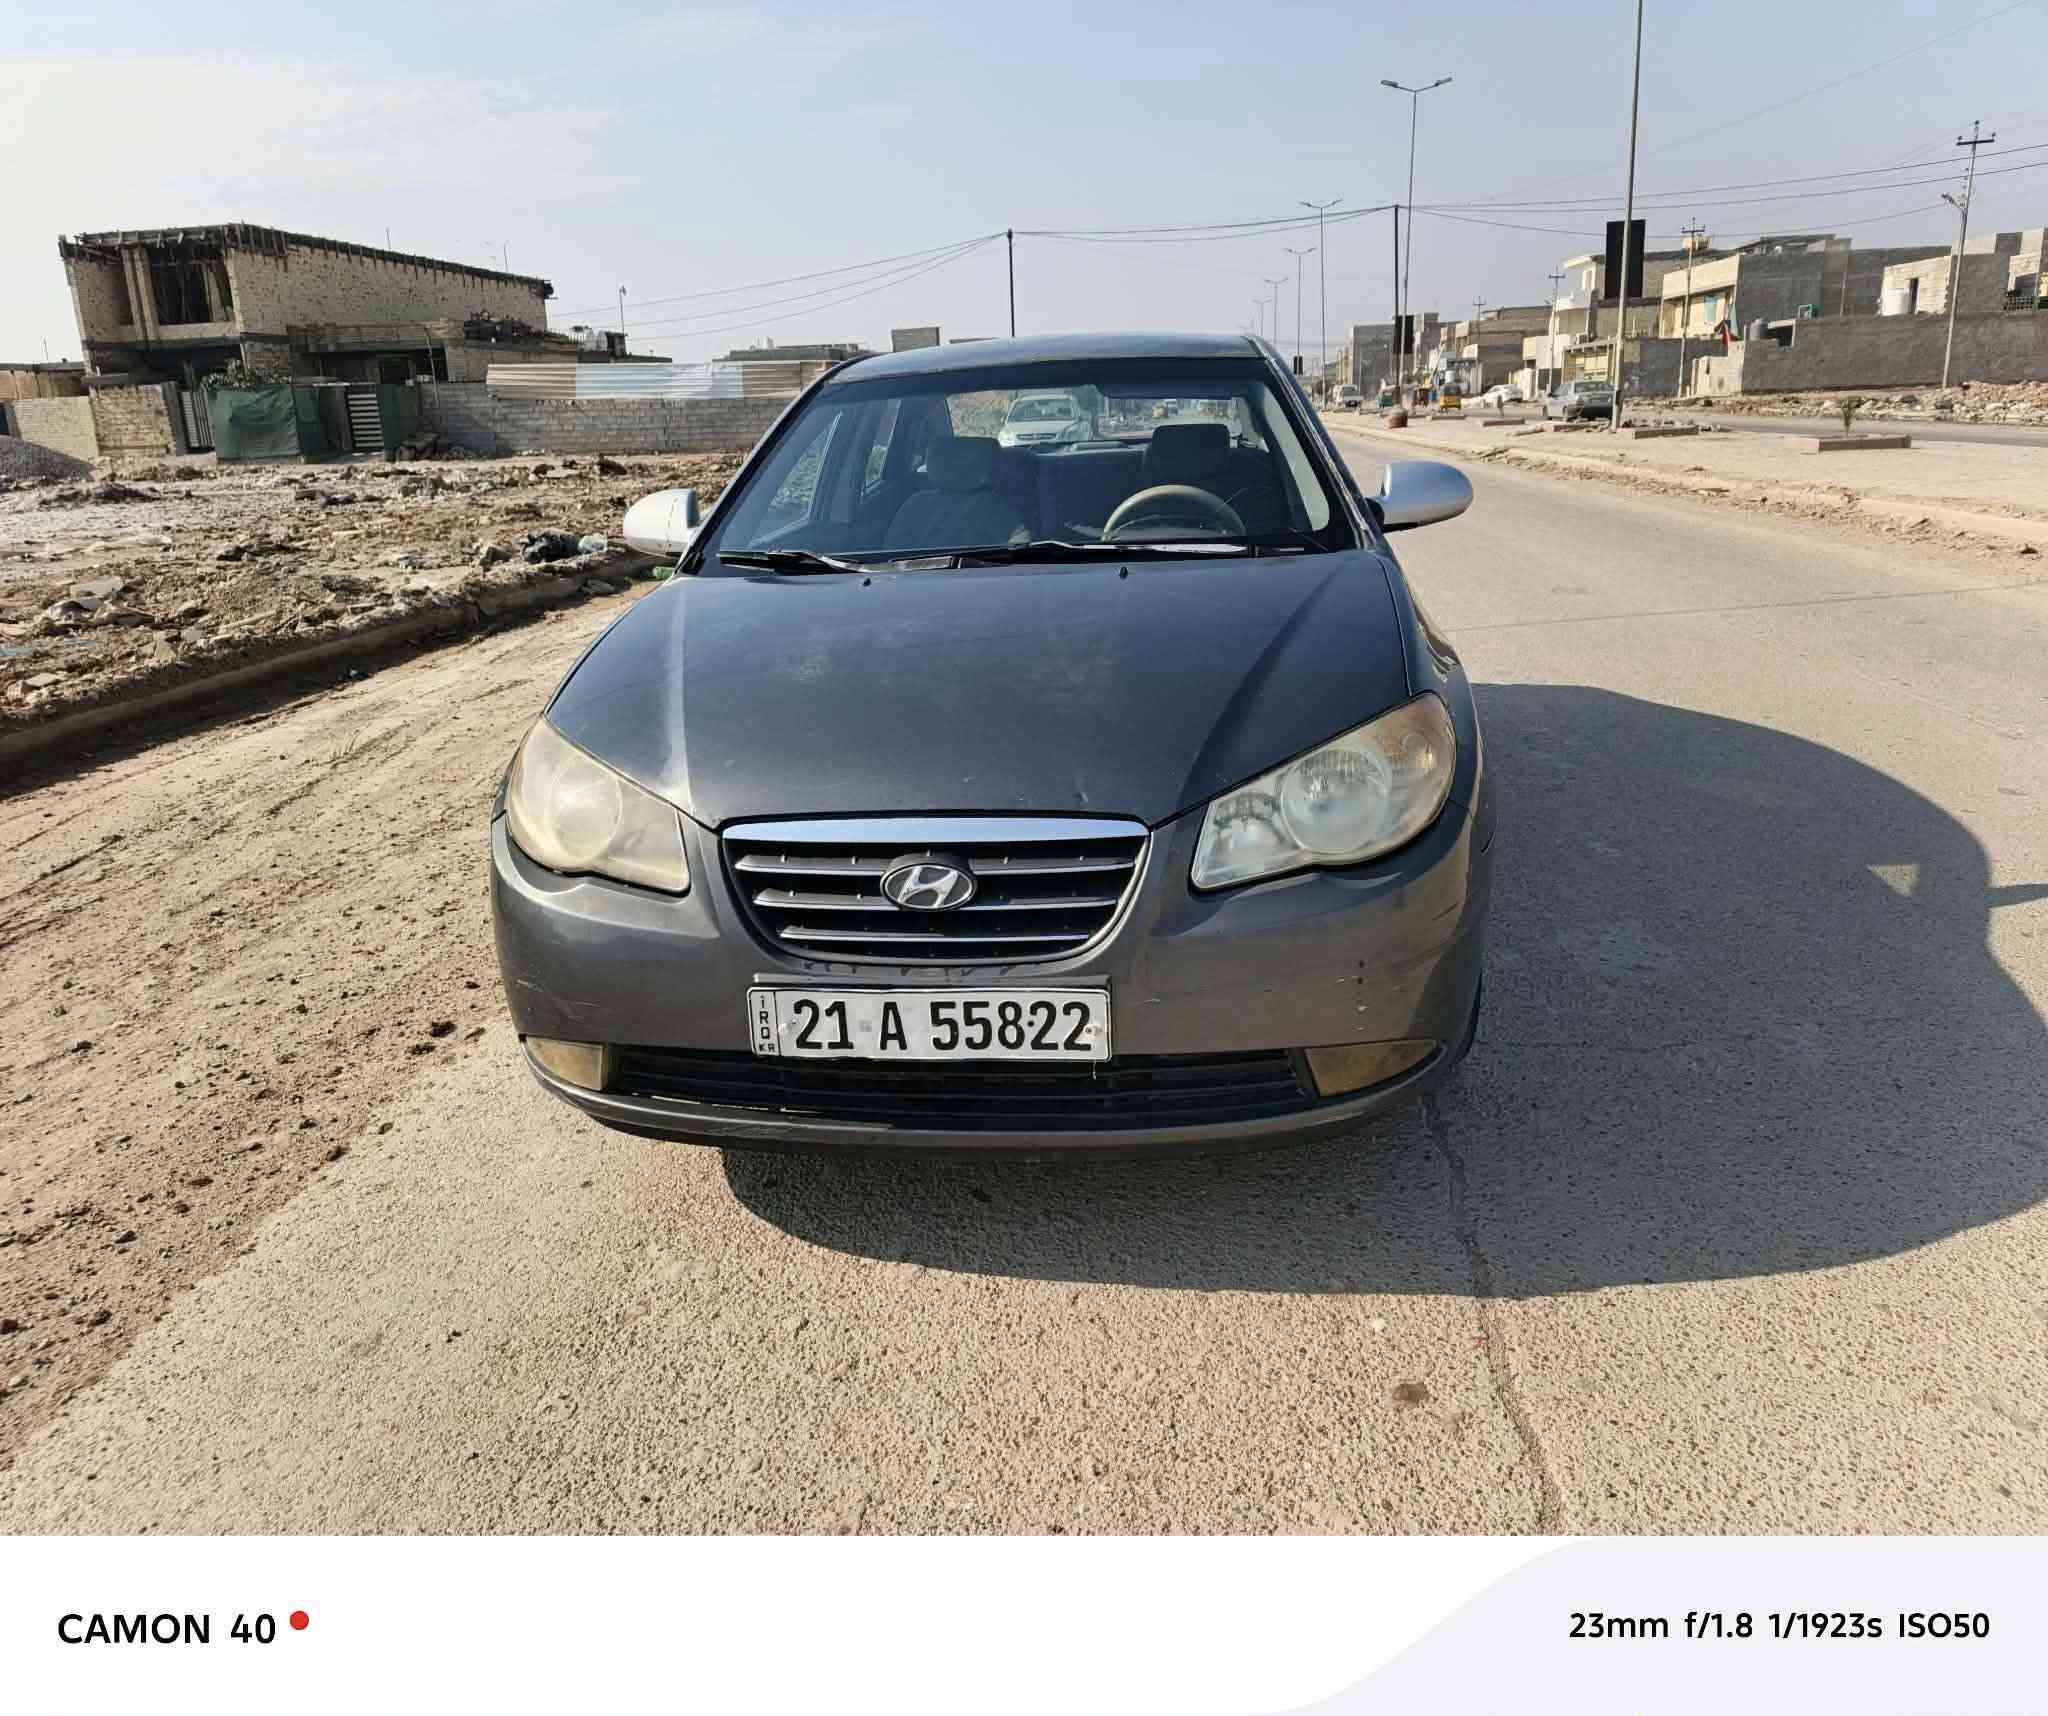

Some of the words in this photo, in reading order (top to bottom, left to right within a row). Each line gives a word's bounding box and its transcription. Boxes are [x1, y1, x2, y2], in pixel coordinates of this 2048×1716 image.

[793, 999, 854, 1050] 21
[879, 1001, 908, 1050] A
[930, 1000, 1092, 1051] 55822
